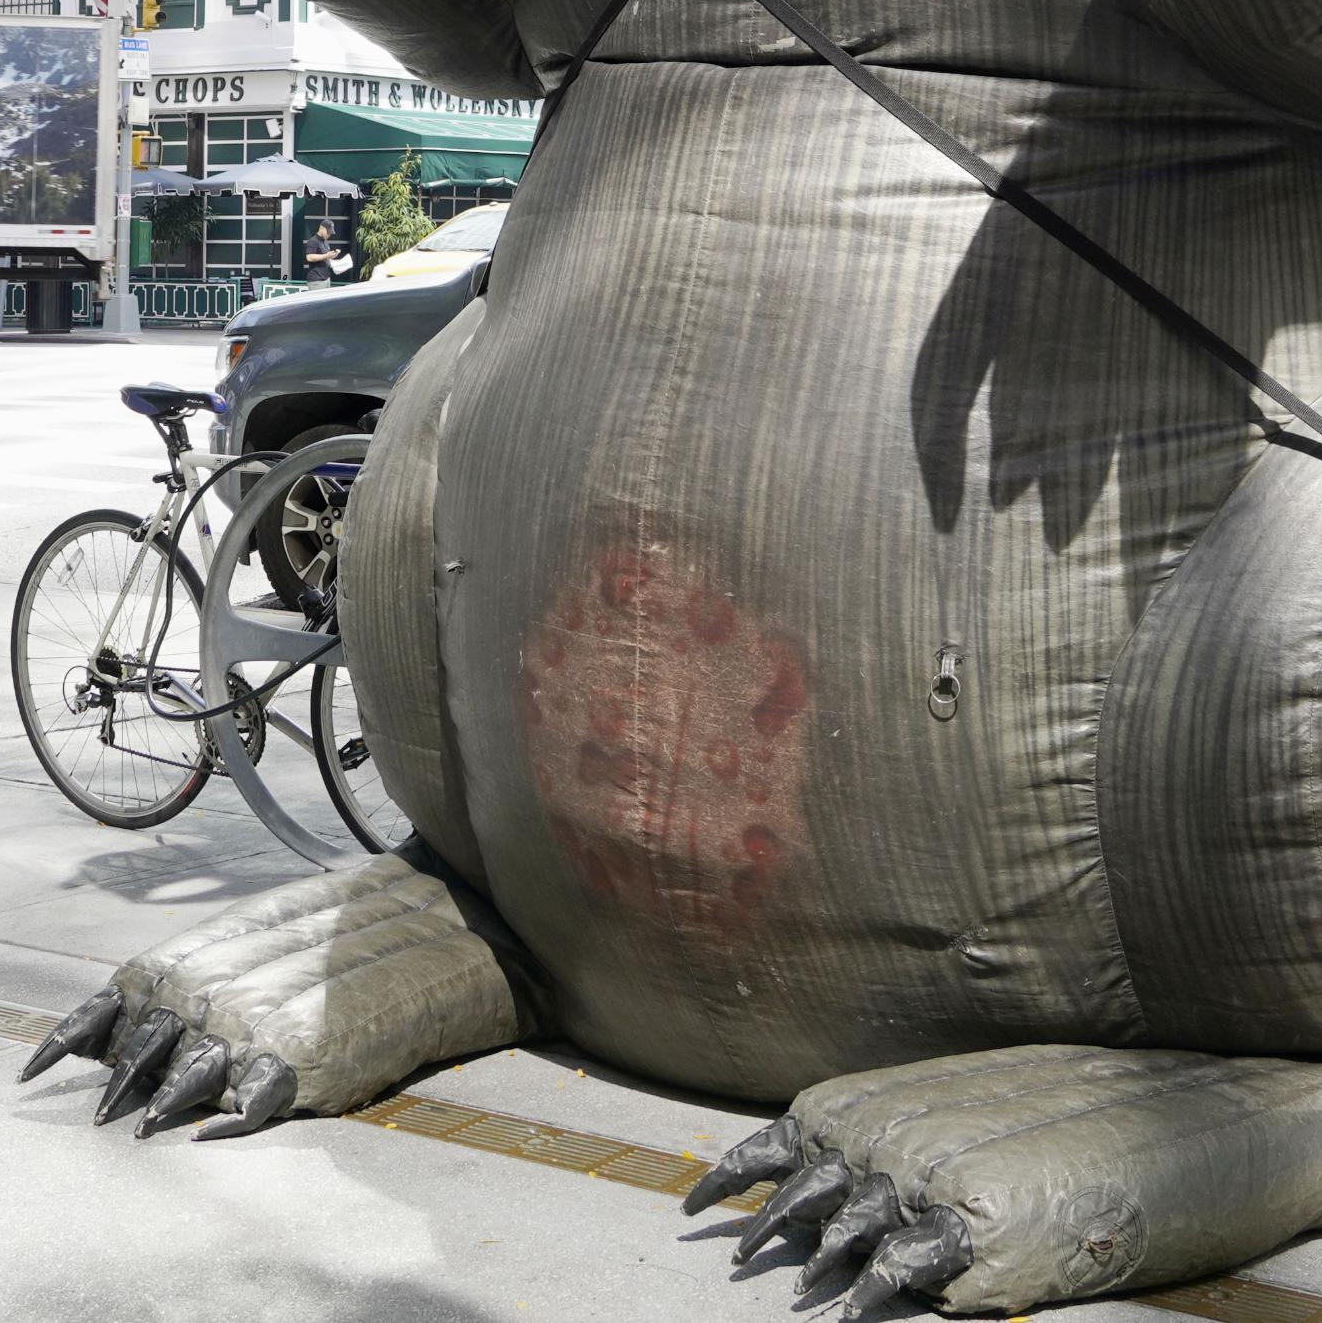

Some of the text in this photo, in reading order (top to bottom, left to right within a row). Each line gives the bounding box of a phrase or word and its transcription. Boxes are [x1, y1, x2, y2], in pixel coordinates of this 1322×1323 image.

[124, 41, 149, 50] BUS LANE
[155, 76, 244, 103] CHOPS
[305, 75, 380, 106] SMITH
[388, 82, 402, 108] &
